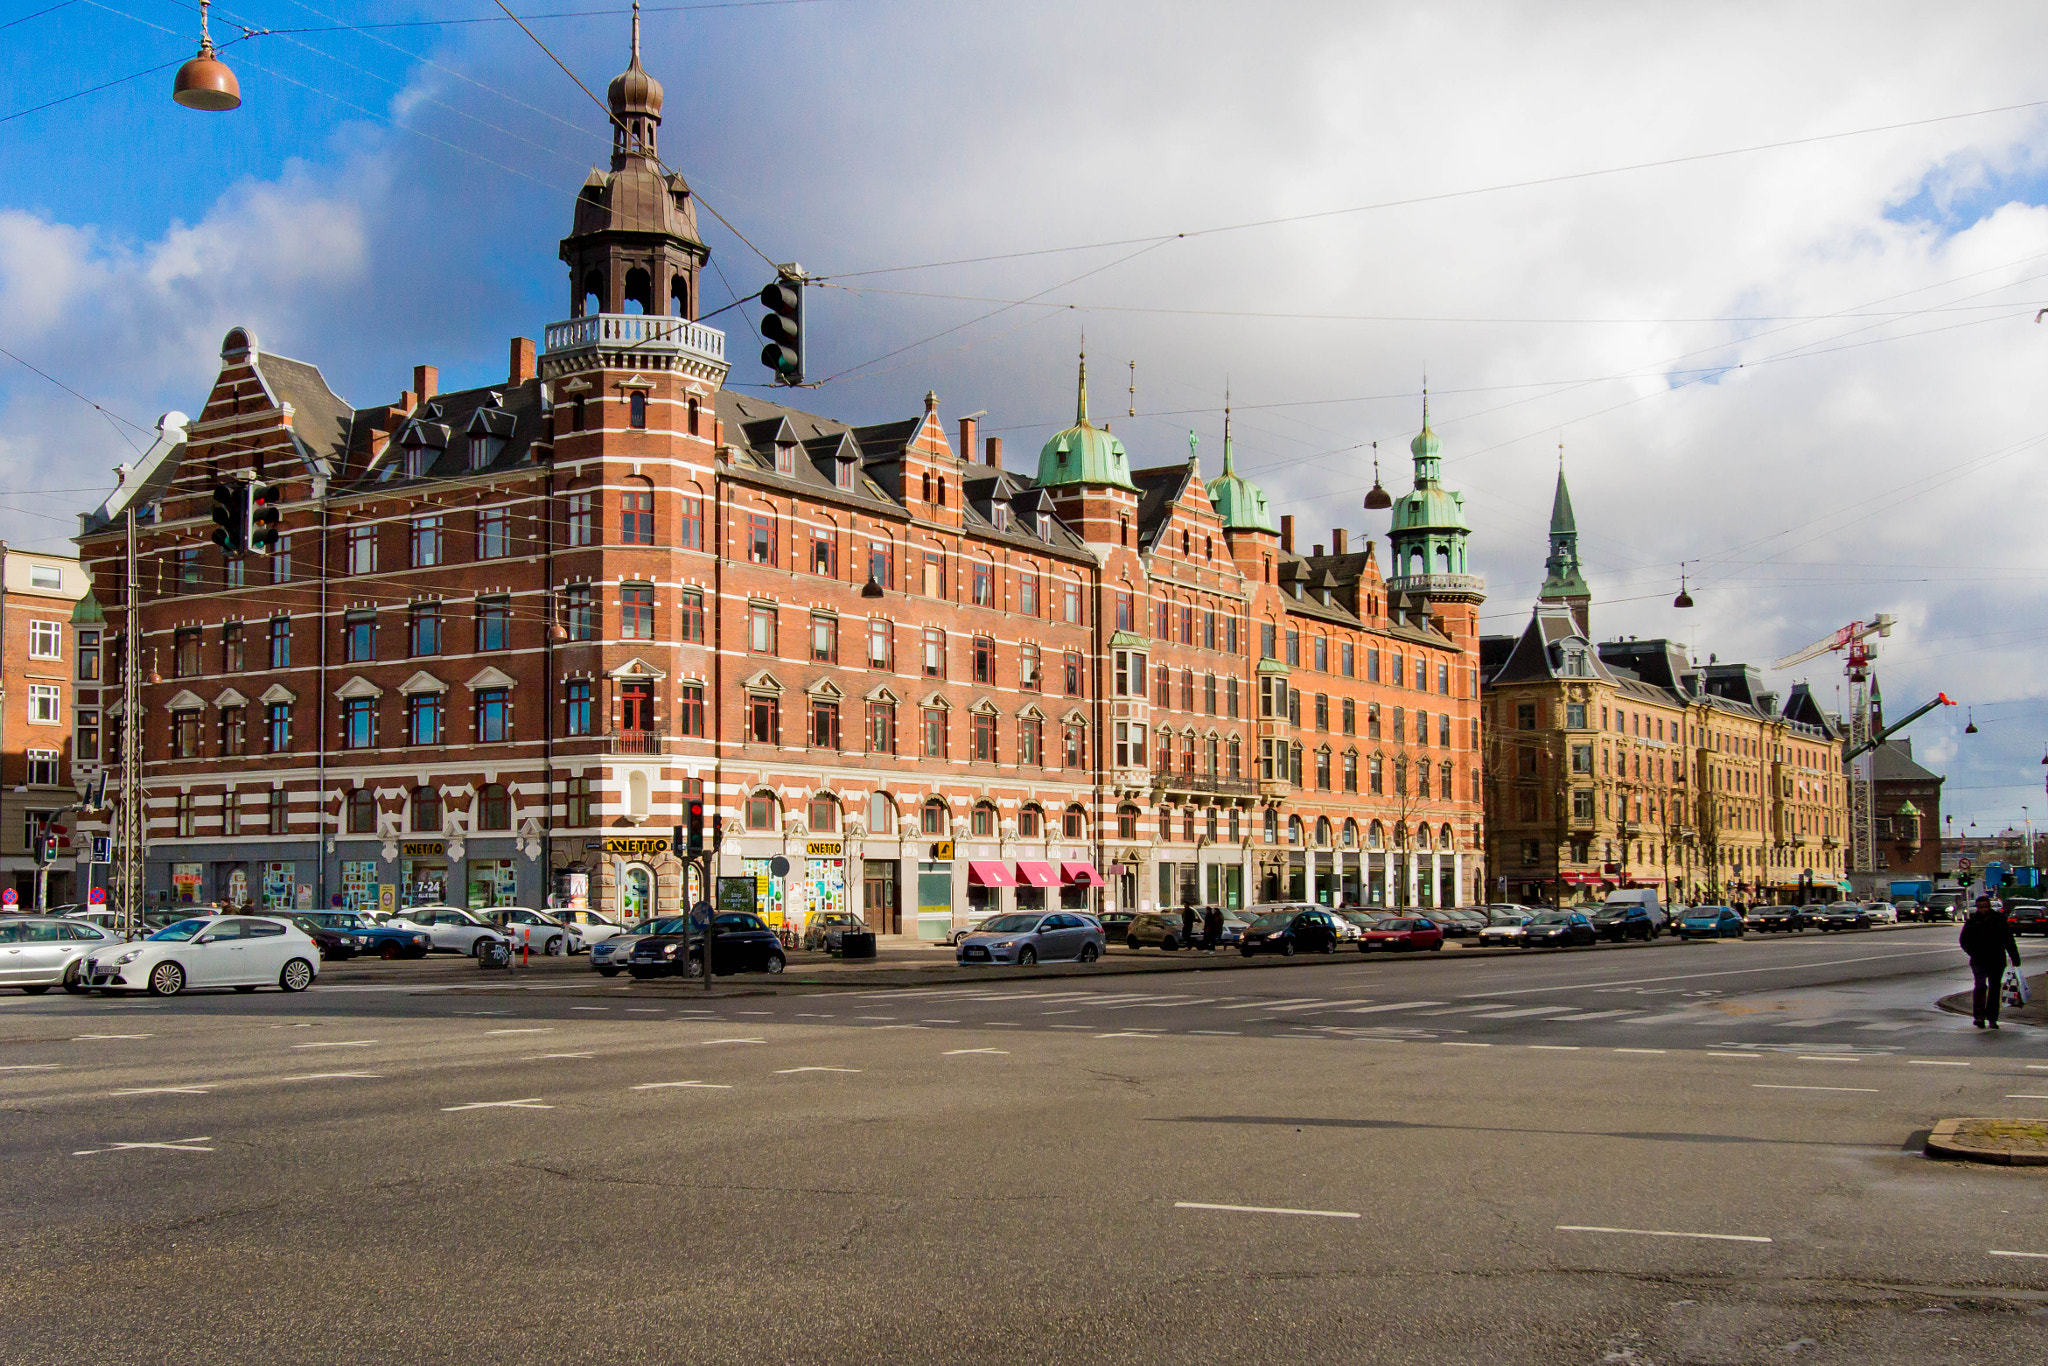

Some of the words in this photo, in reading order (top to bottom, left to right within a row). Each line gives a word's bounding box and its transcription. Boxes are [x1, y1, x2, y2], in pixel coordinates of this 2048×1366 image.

[404, 843, 443, 855] NETTO
[608, 839, 668, 853] NETTO
[808, 842, 841, 854] NETTO
[417, 881, 440, 892] 7-24
